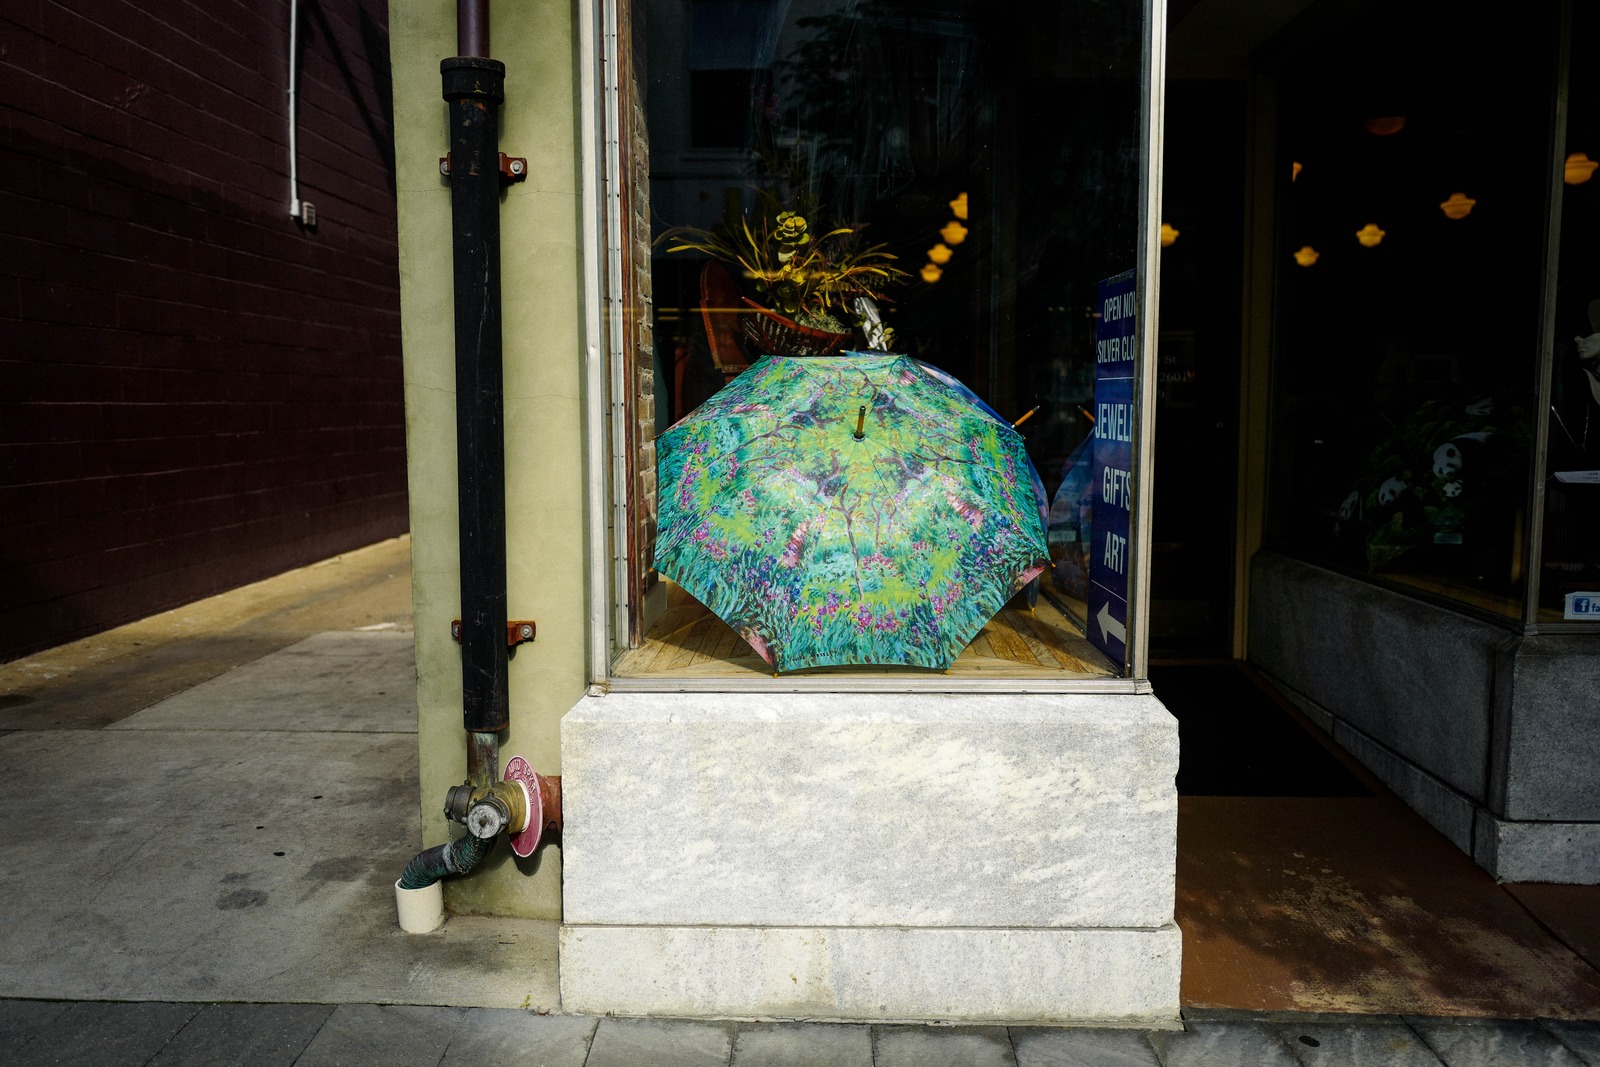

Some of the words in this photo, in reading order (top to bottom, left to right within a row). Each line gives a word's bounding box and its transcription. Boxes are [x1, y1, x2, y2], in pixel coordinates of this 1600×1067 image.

[1103, 295, 1122, 323] OPEN
[1097, 337, 1120, 364] SILVER
[1103, 466, 1131, 511] GIFTS
[1103, 531, 1126, 575] ART
[508, 759, 521, 777] AUTO
